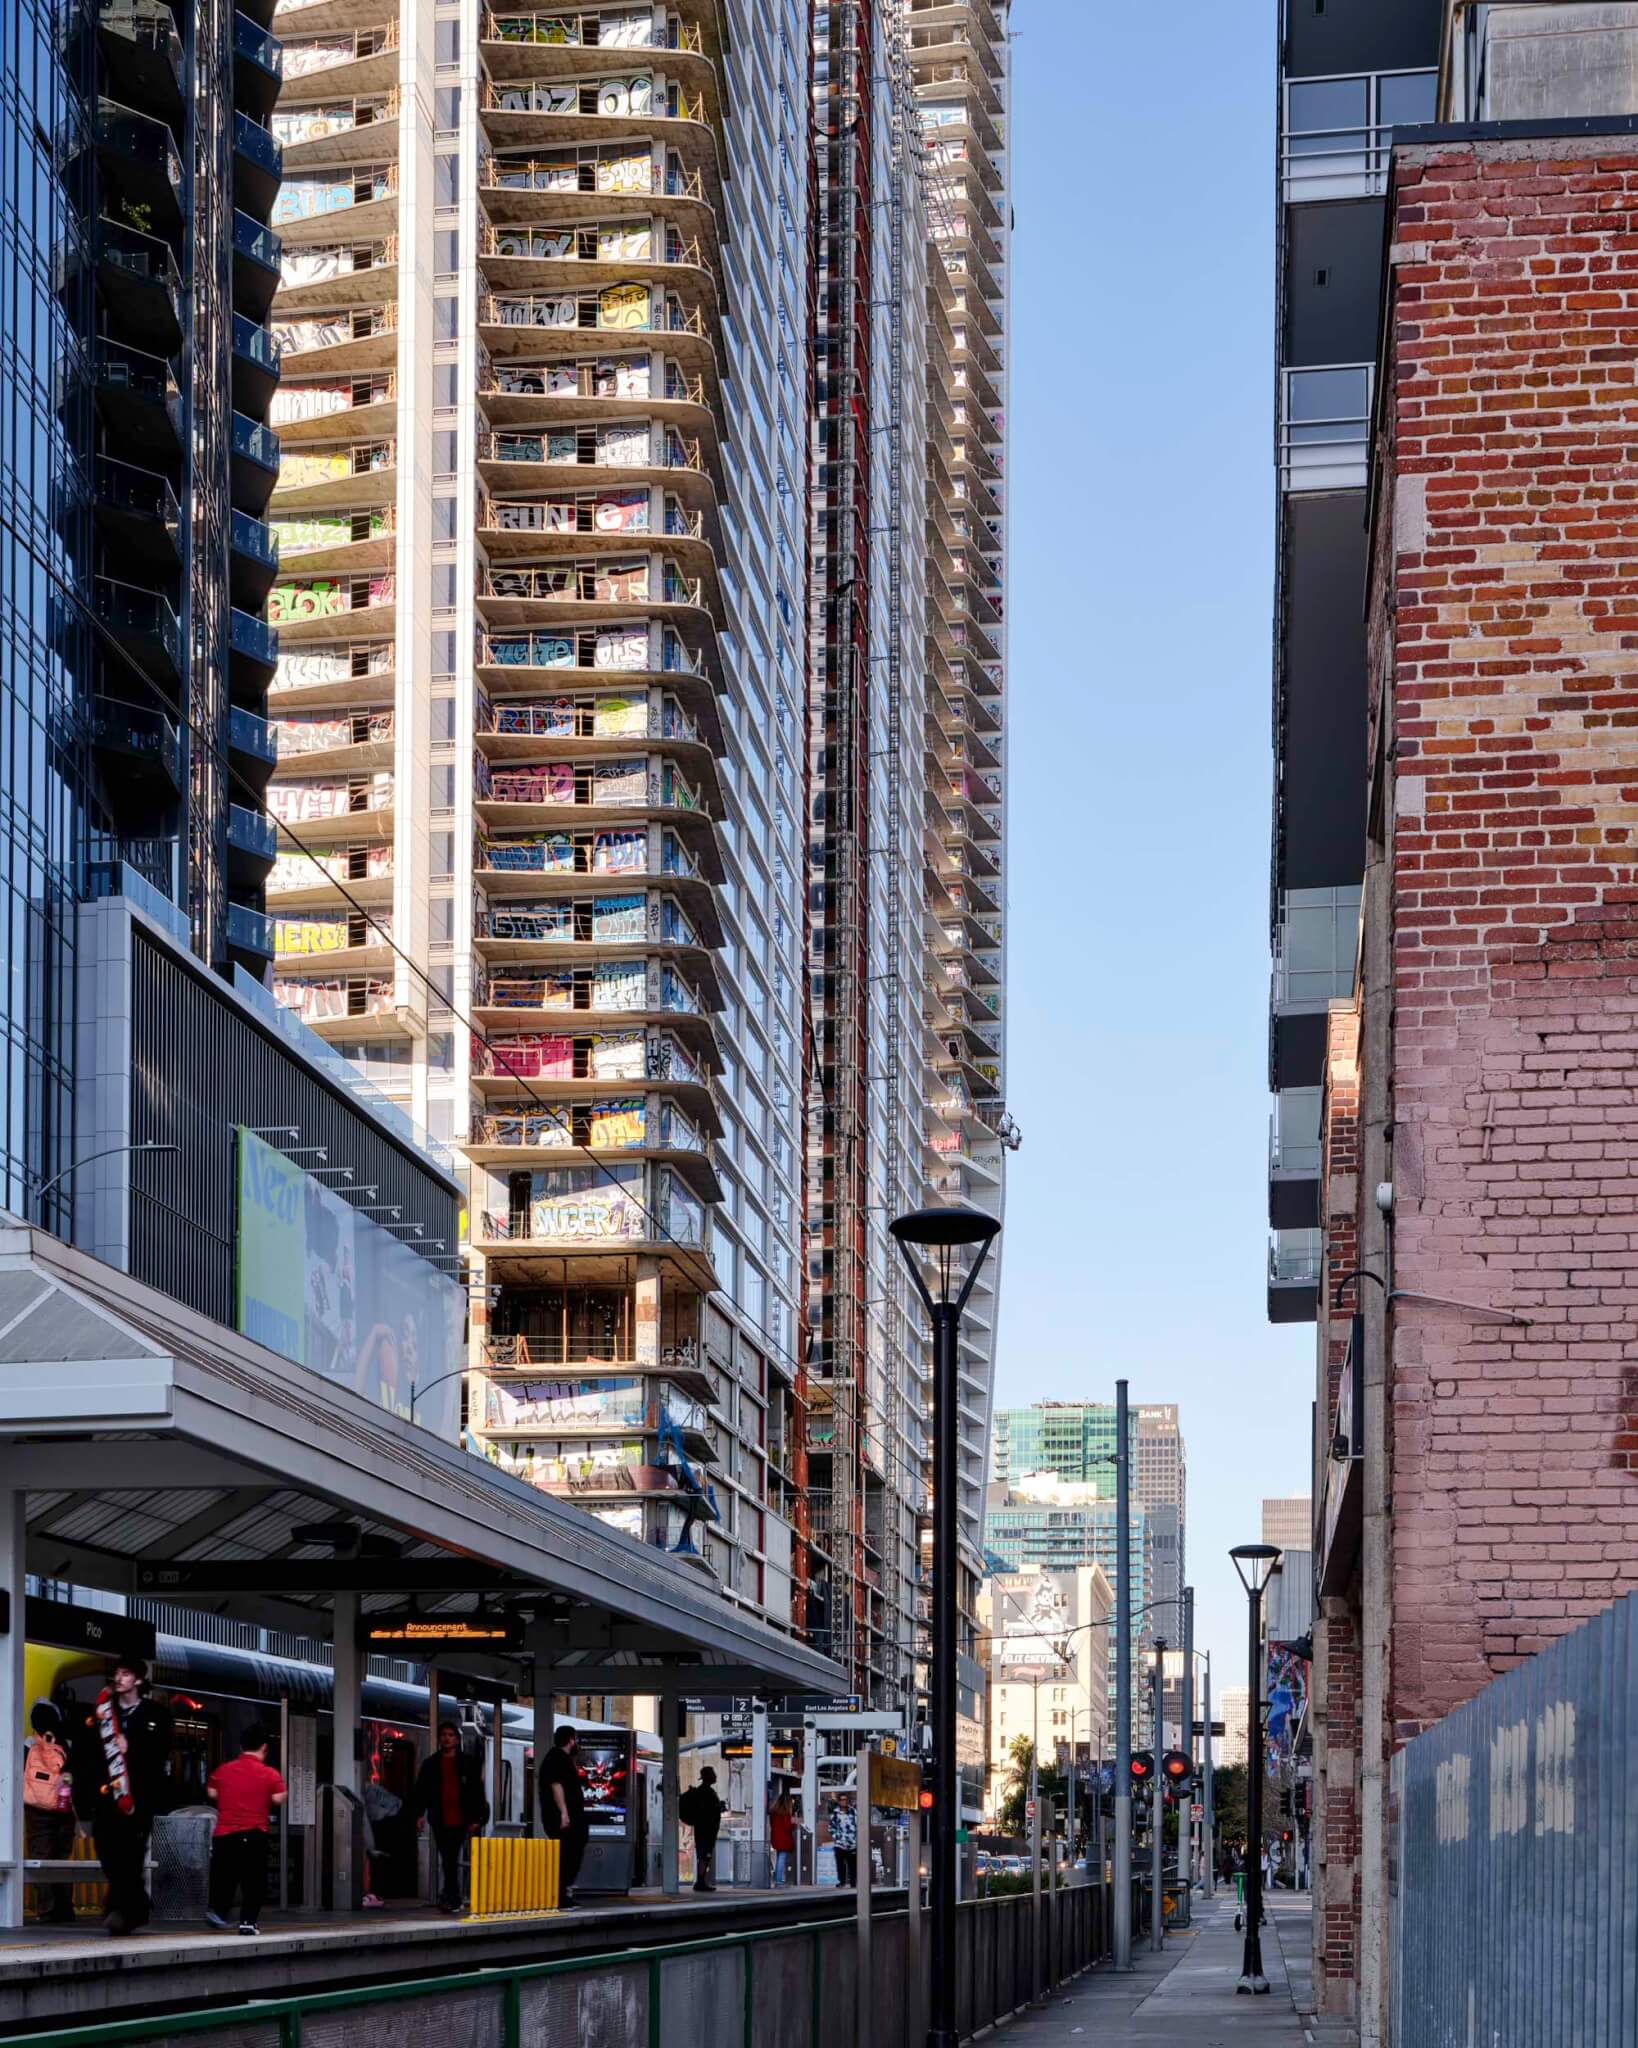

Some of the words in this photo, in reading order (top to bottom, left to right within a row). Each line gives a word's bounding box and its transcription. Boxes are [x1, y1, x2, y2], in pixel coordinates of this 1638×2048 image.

[86, 1621, 103, 1639] Pico
[406, 1623, 468, 1632] Announcement
[739, 1701, 747, 1712] 2
